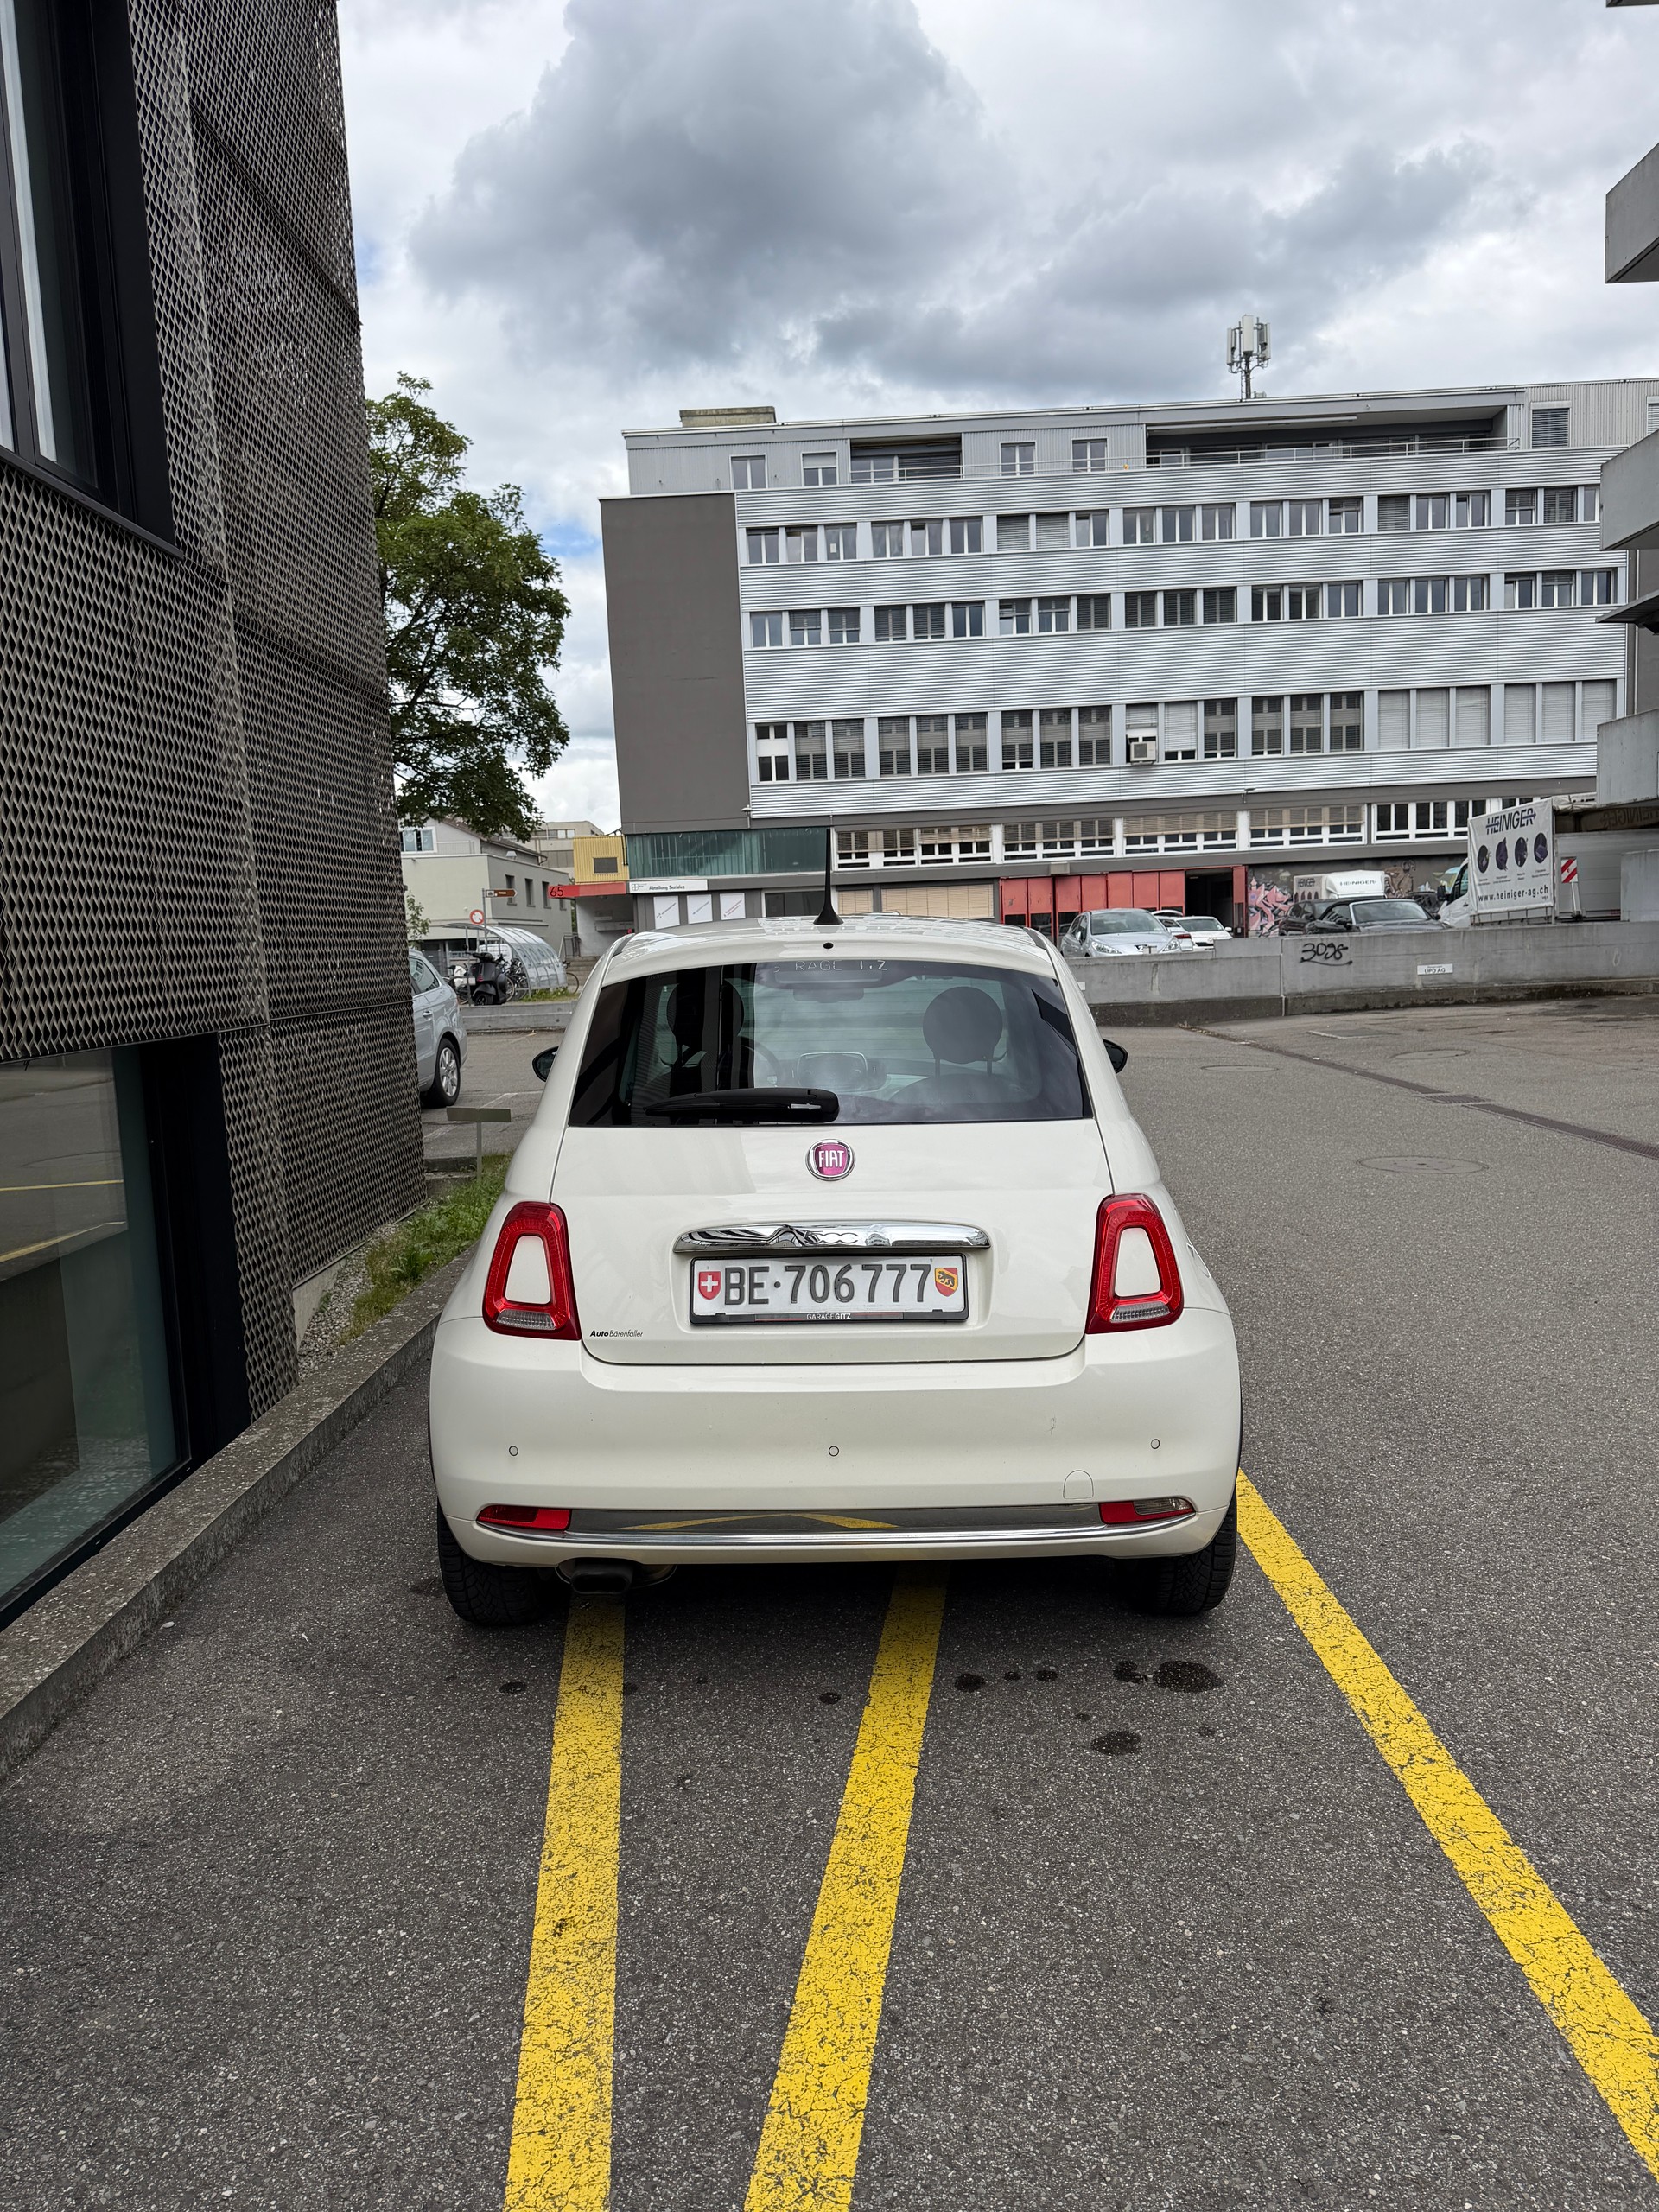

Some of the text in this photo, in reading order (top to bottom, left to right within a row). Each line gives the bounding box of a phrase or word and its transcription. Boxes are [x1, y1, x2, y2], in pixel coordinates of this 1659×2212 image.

[1486, 808, 1535, 835] HEINIGER
[550, 886, 564, 898] 65
[1478, 884, 1548, 902] www.heiniger-ag.ch
[818, 1150, 844, 1168] FIAT
